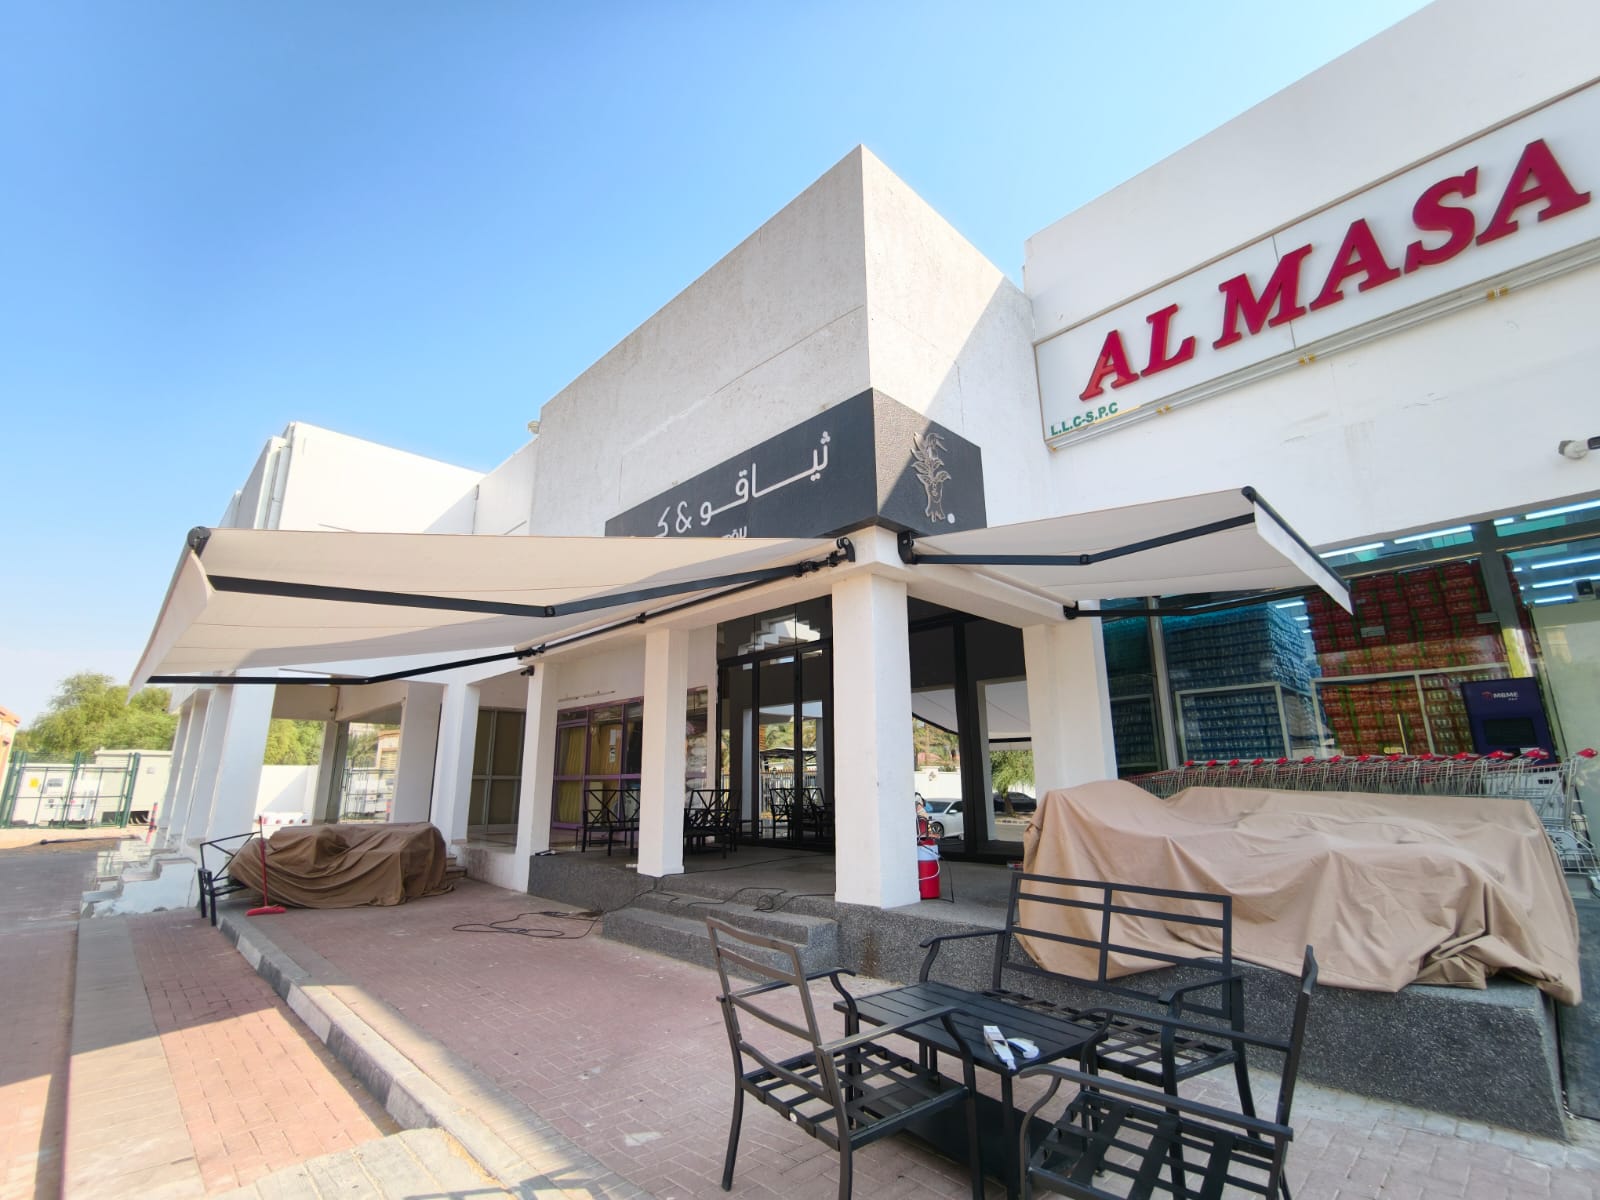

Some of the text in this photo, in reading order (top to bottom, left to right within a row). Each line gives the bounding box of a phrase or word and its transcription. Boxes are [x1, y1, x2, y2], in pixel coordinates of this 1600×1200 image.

[1080, 138, 1590, 401] AL MASA
[1050, 402, 1119, 436] L.L.C-S.P.C
[675, 500, 693, 534] &
